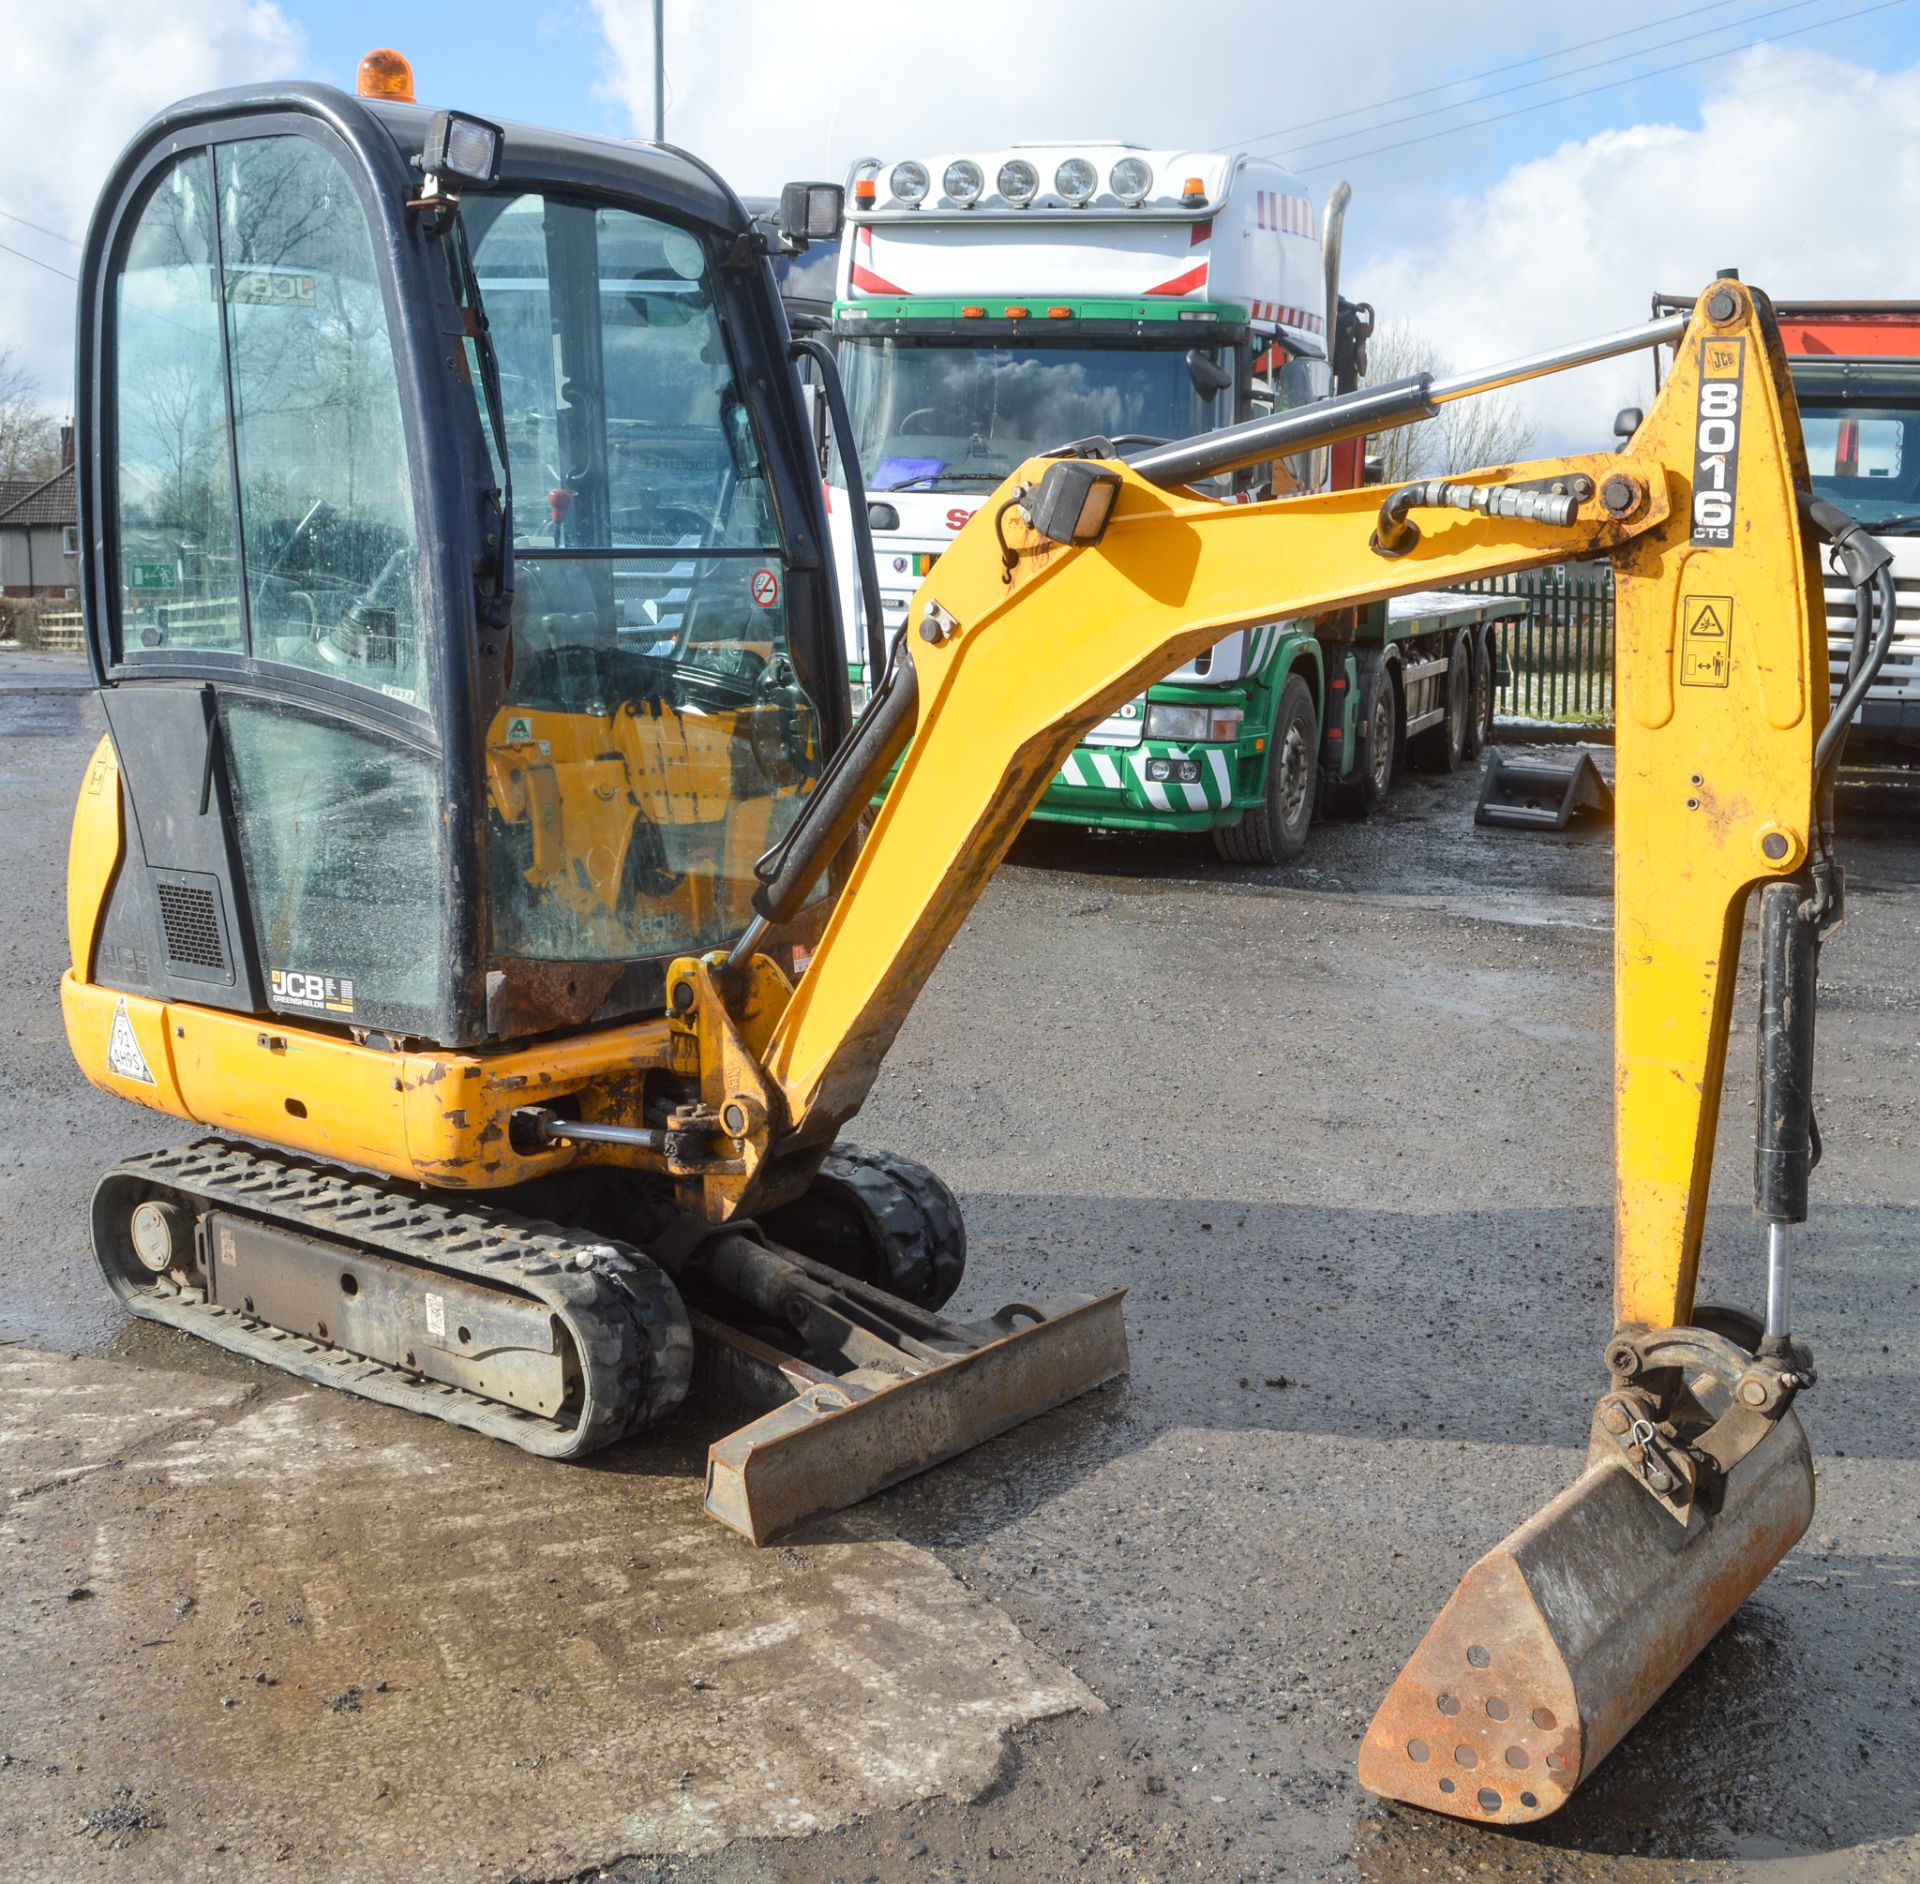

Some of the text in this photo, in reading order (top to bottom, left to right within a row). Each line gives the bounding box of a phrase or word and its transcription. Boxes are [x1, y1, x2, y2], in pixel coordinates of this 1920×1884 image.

[1713, 351, 1734, 369] JCB
[1695, 383, 1738, 526] 8016
[945, 508, 978, 531] S
[1693, 527, 1730, 539] CTS
[271, 970, 325, 1001] JCB
